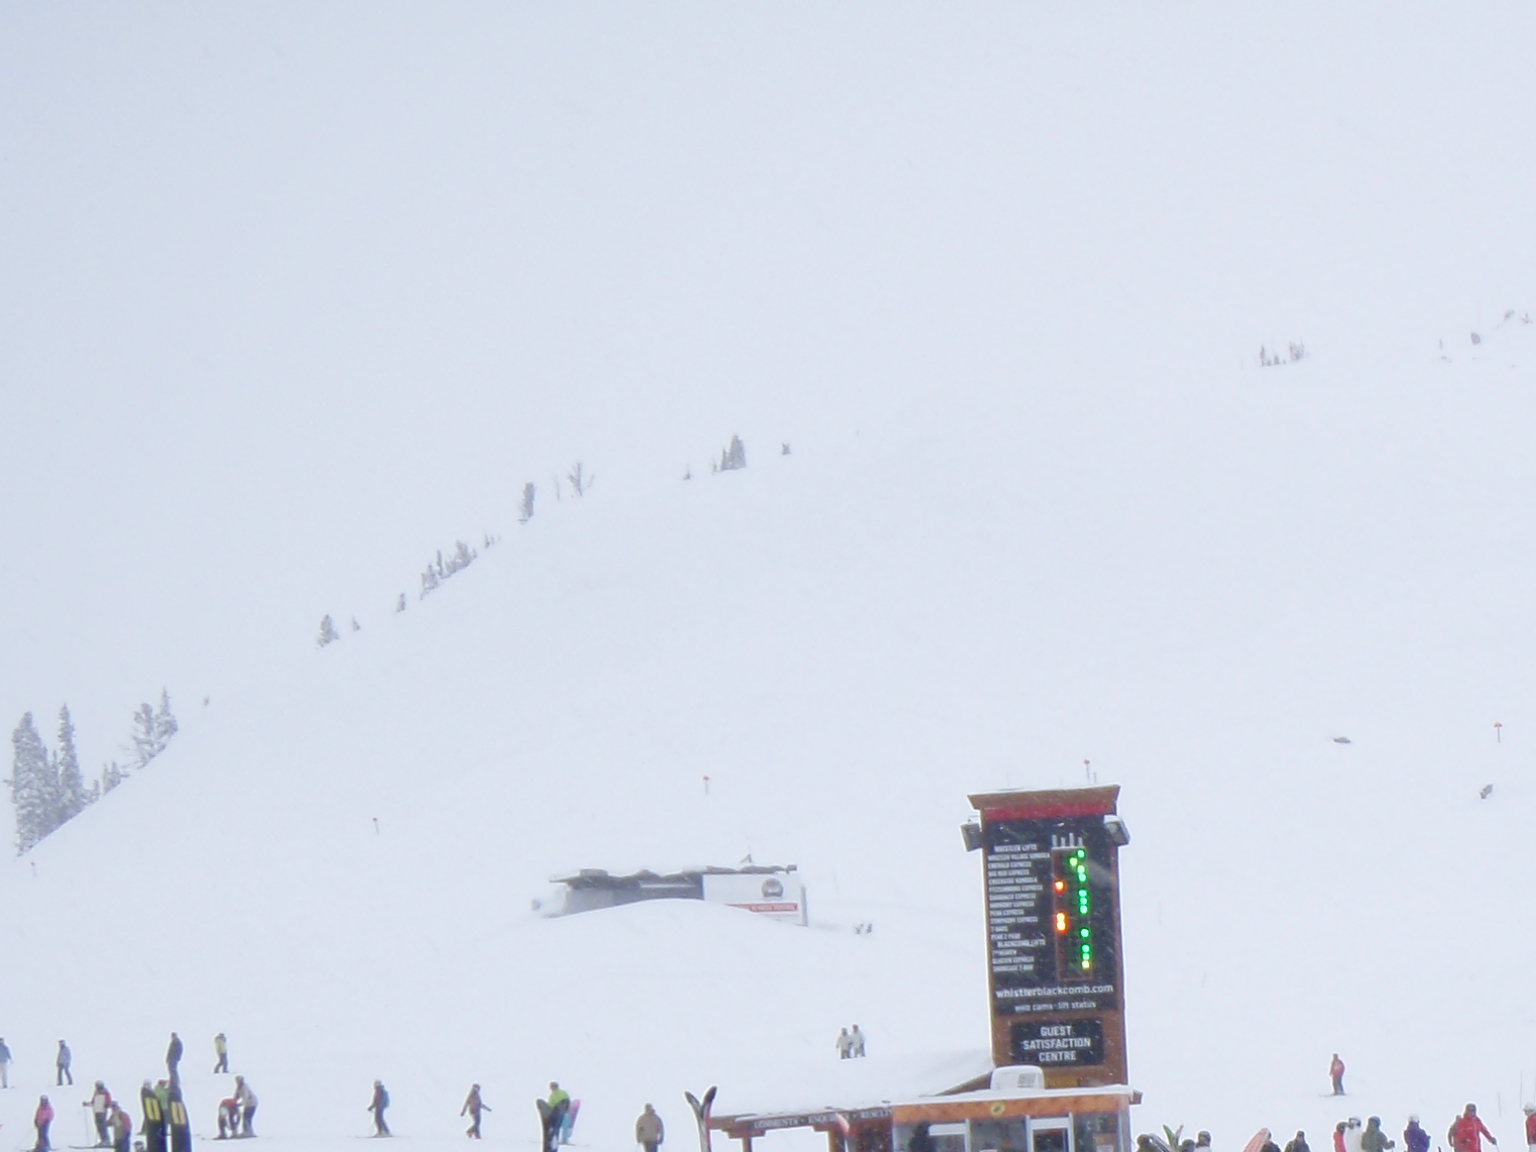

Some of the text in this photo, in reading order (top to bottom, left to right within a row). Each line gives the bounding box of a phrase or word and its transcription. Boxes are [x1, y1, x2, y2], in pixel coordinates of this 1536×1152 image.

[996, 984, 1114, 999] whistlerblackcomb.com
[1040, 1026, 1072, 1036] GUEST
[1022, 1037, 1091, 1050] SATISFACTION
[1038, 1050, 1077, 1062] CENTRE
